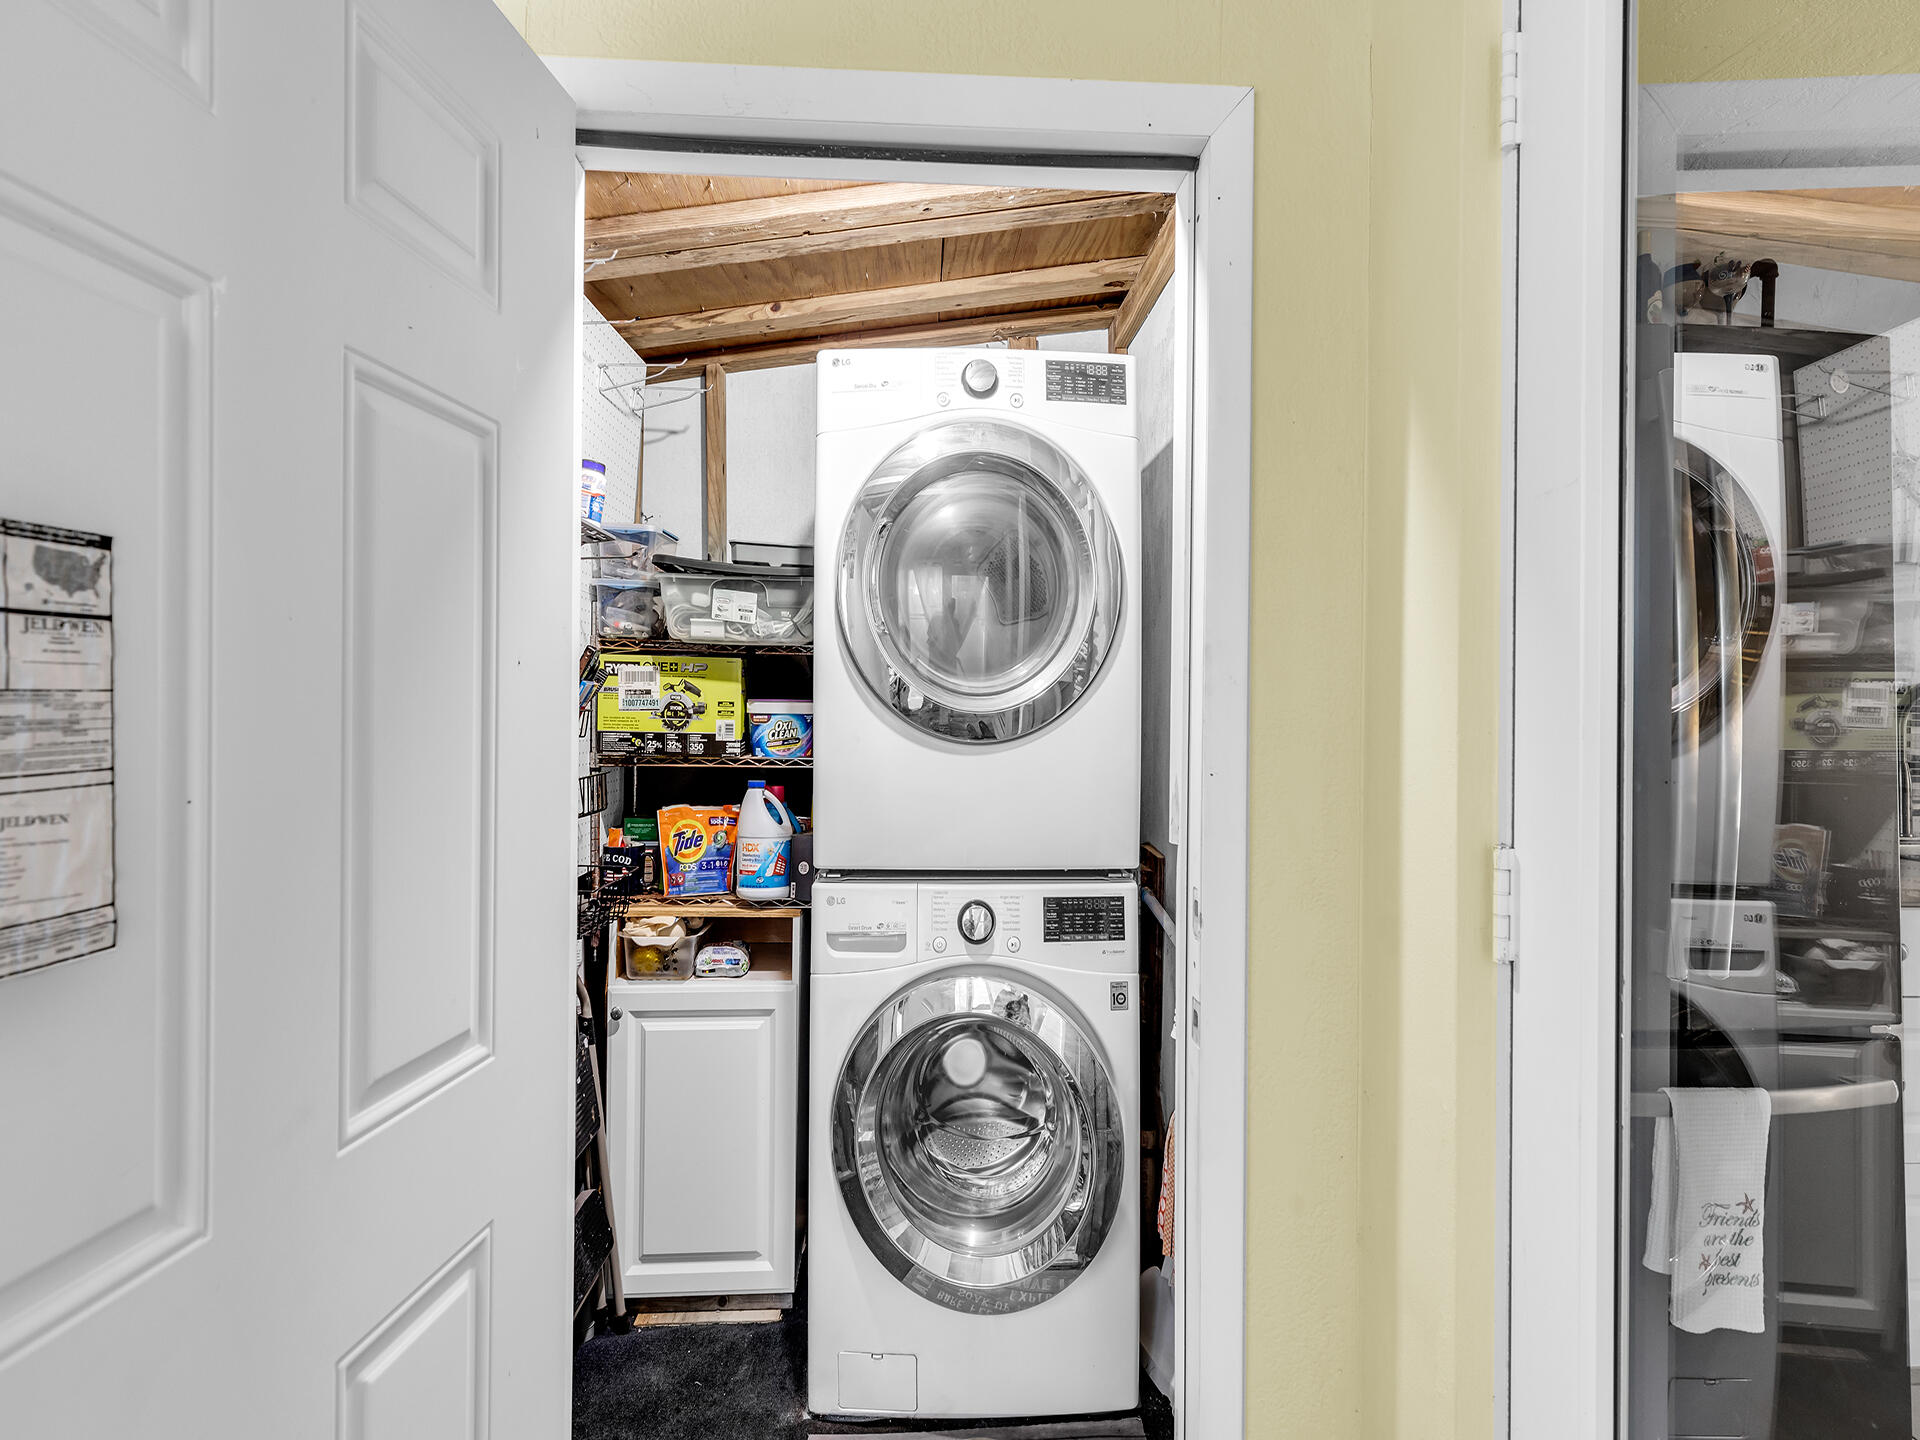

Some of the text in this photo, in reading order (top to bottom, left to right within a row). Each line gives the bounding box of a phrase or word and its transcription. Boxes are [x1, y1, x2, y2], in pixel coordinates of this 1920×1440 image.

[775, 720, 792, 731] OXI
[769, 728, 797, 740] CLEAN
[690, 743, 704, 751] 350
[673, 829, 704, 856] Tide
[742, 843, 760, 852] HDX
[612, 855, 631, 865] COD
[1112, 992, 1126, 1005] 10
[1699, 1203, 1760, 1228] Friends
[1729, 1228, 1754, 1247] the
[1702, 1272, 1760, 1296] presents
